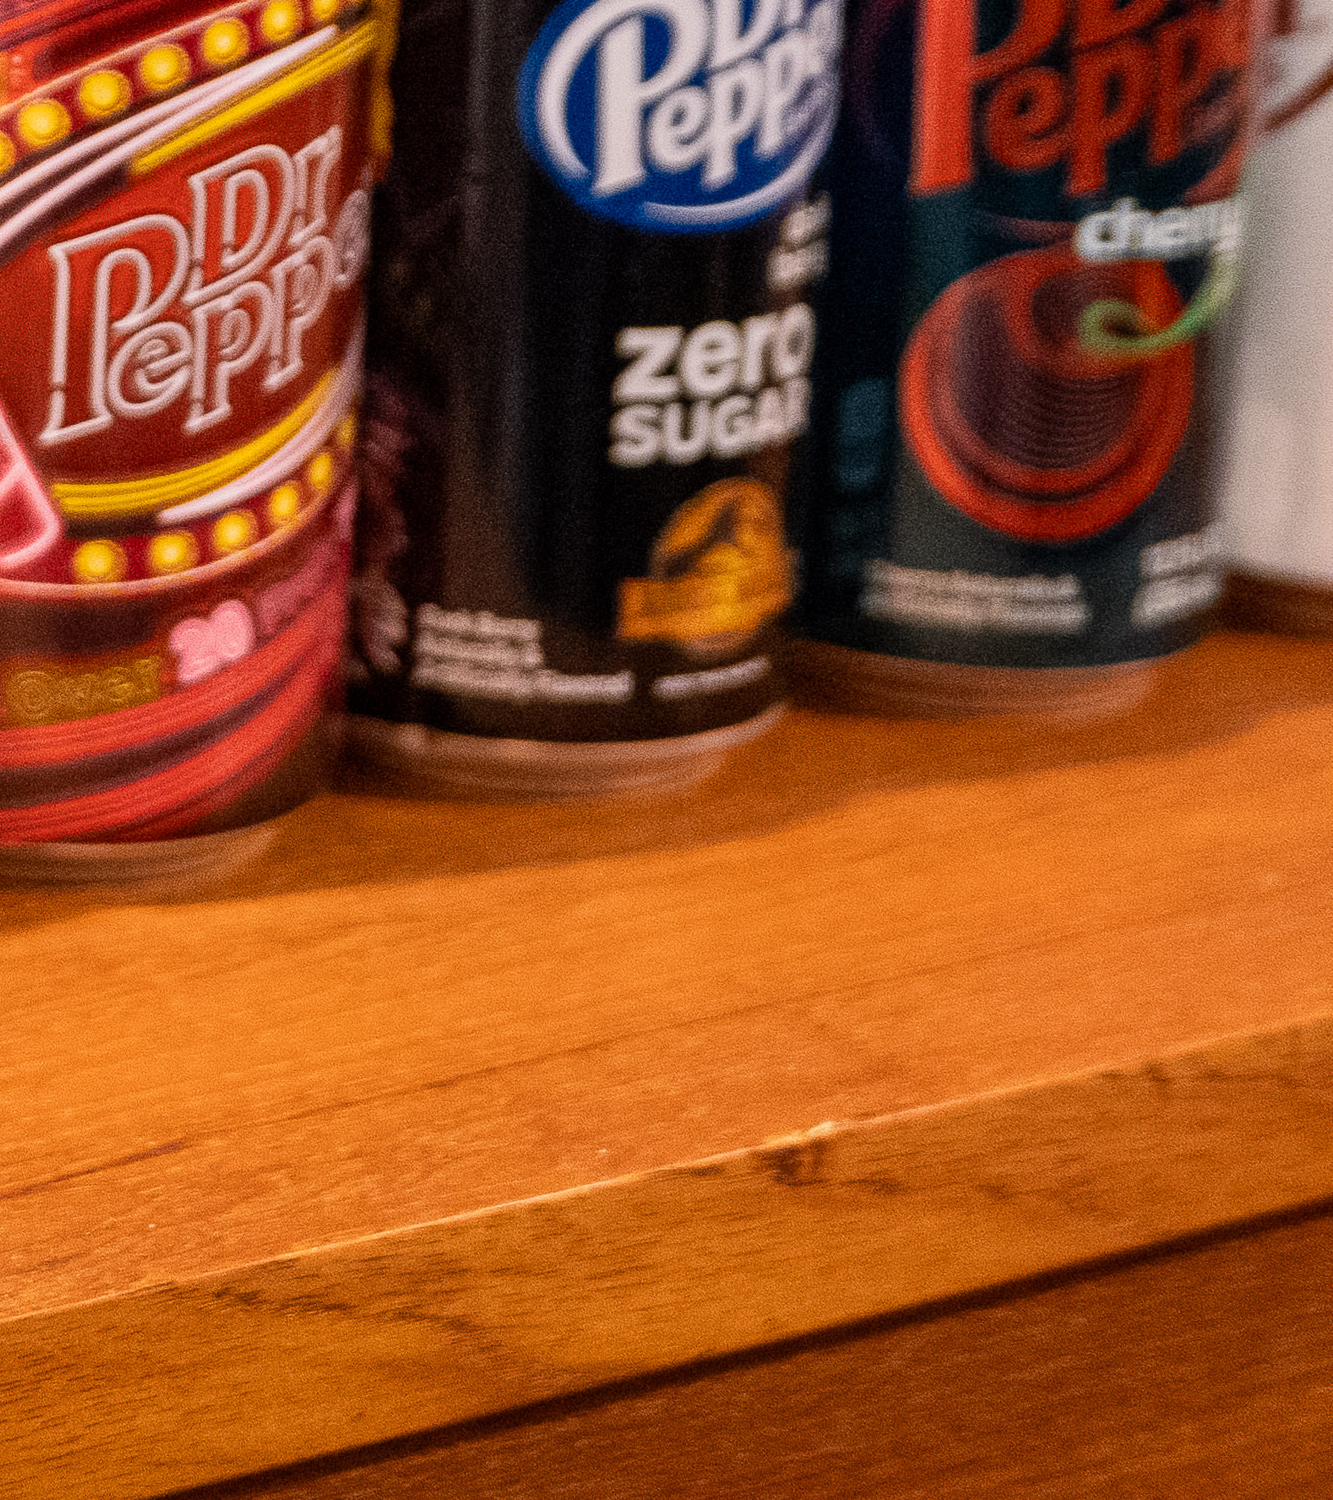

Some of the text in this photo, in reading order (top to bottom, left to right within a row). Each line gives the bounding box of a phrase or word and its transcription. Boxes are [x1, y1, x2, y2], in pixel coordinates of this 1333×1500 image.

[187, 124, 343, 306] Dr
[39, 168, 372, 446] Peppe
[611, 301, 818, 402] zero
